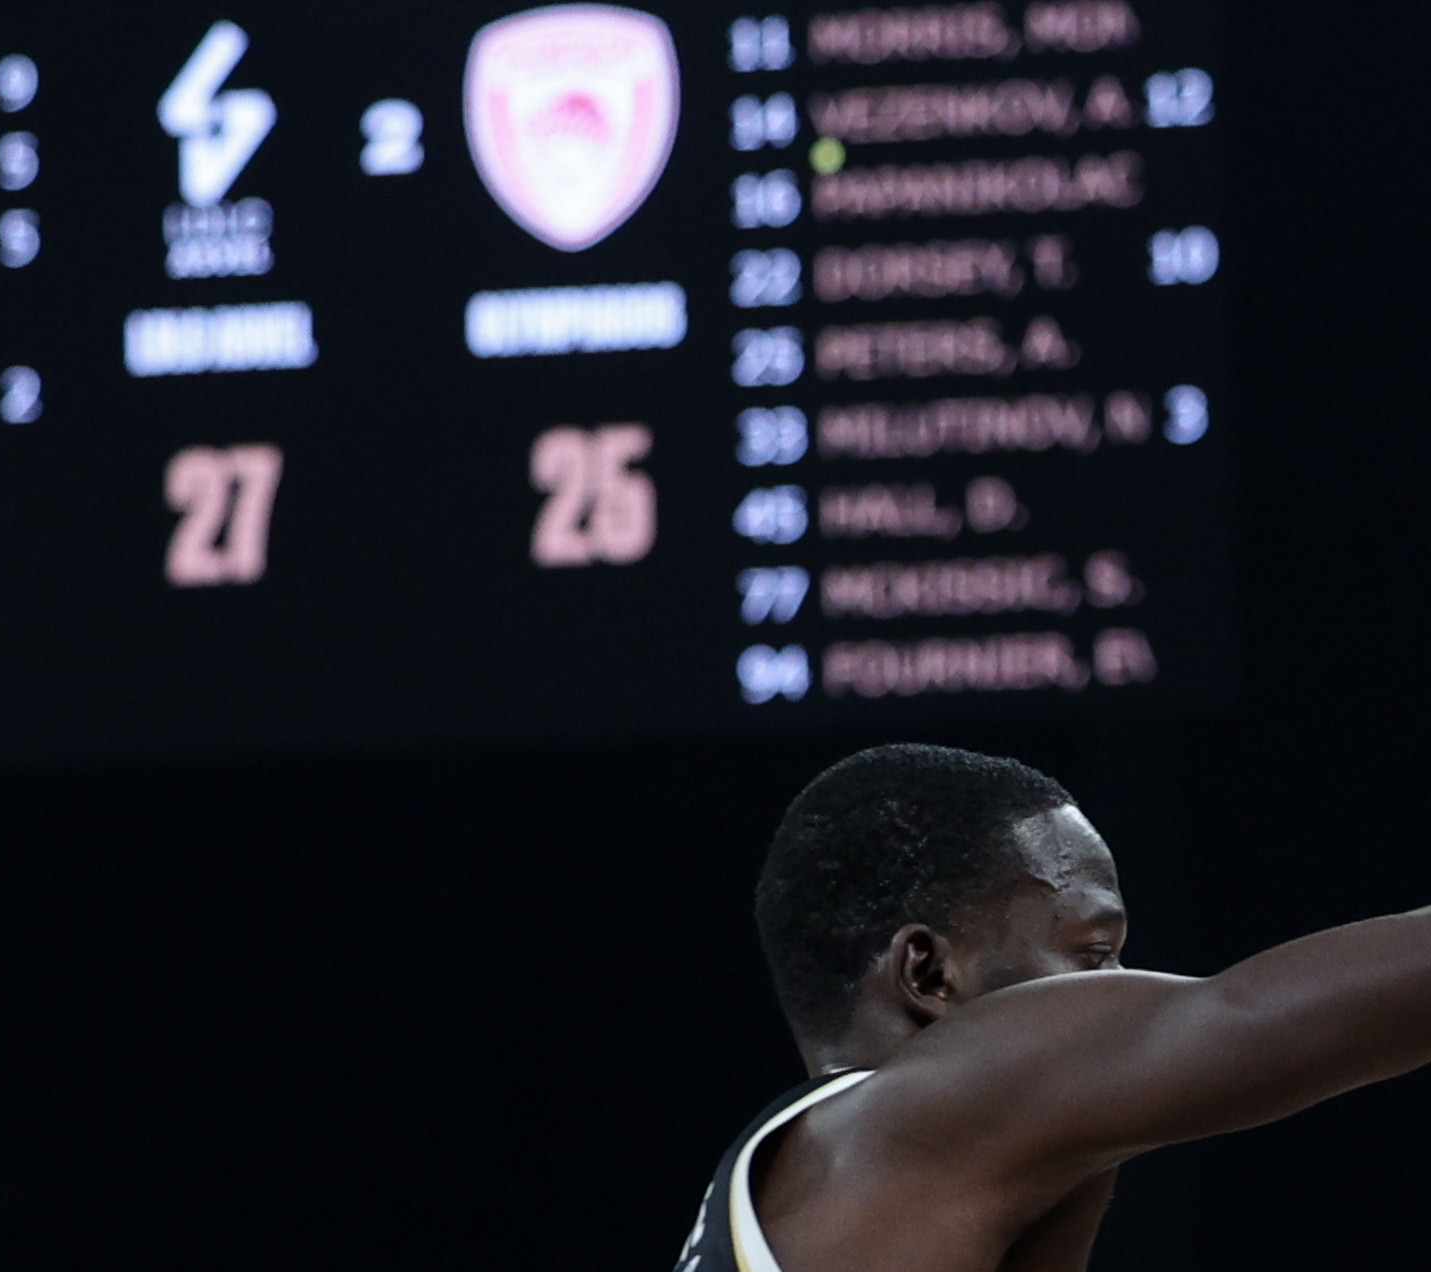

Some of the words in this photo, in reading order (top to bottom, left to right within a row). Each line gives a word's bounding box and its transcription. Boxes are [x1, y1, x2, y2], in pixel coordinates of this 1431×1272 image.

[1145, 68, 1213, 128] 12
[164, 444, 283, 587] 27
[530, 424, 656, 567] 25
